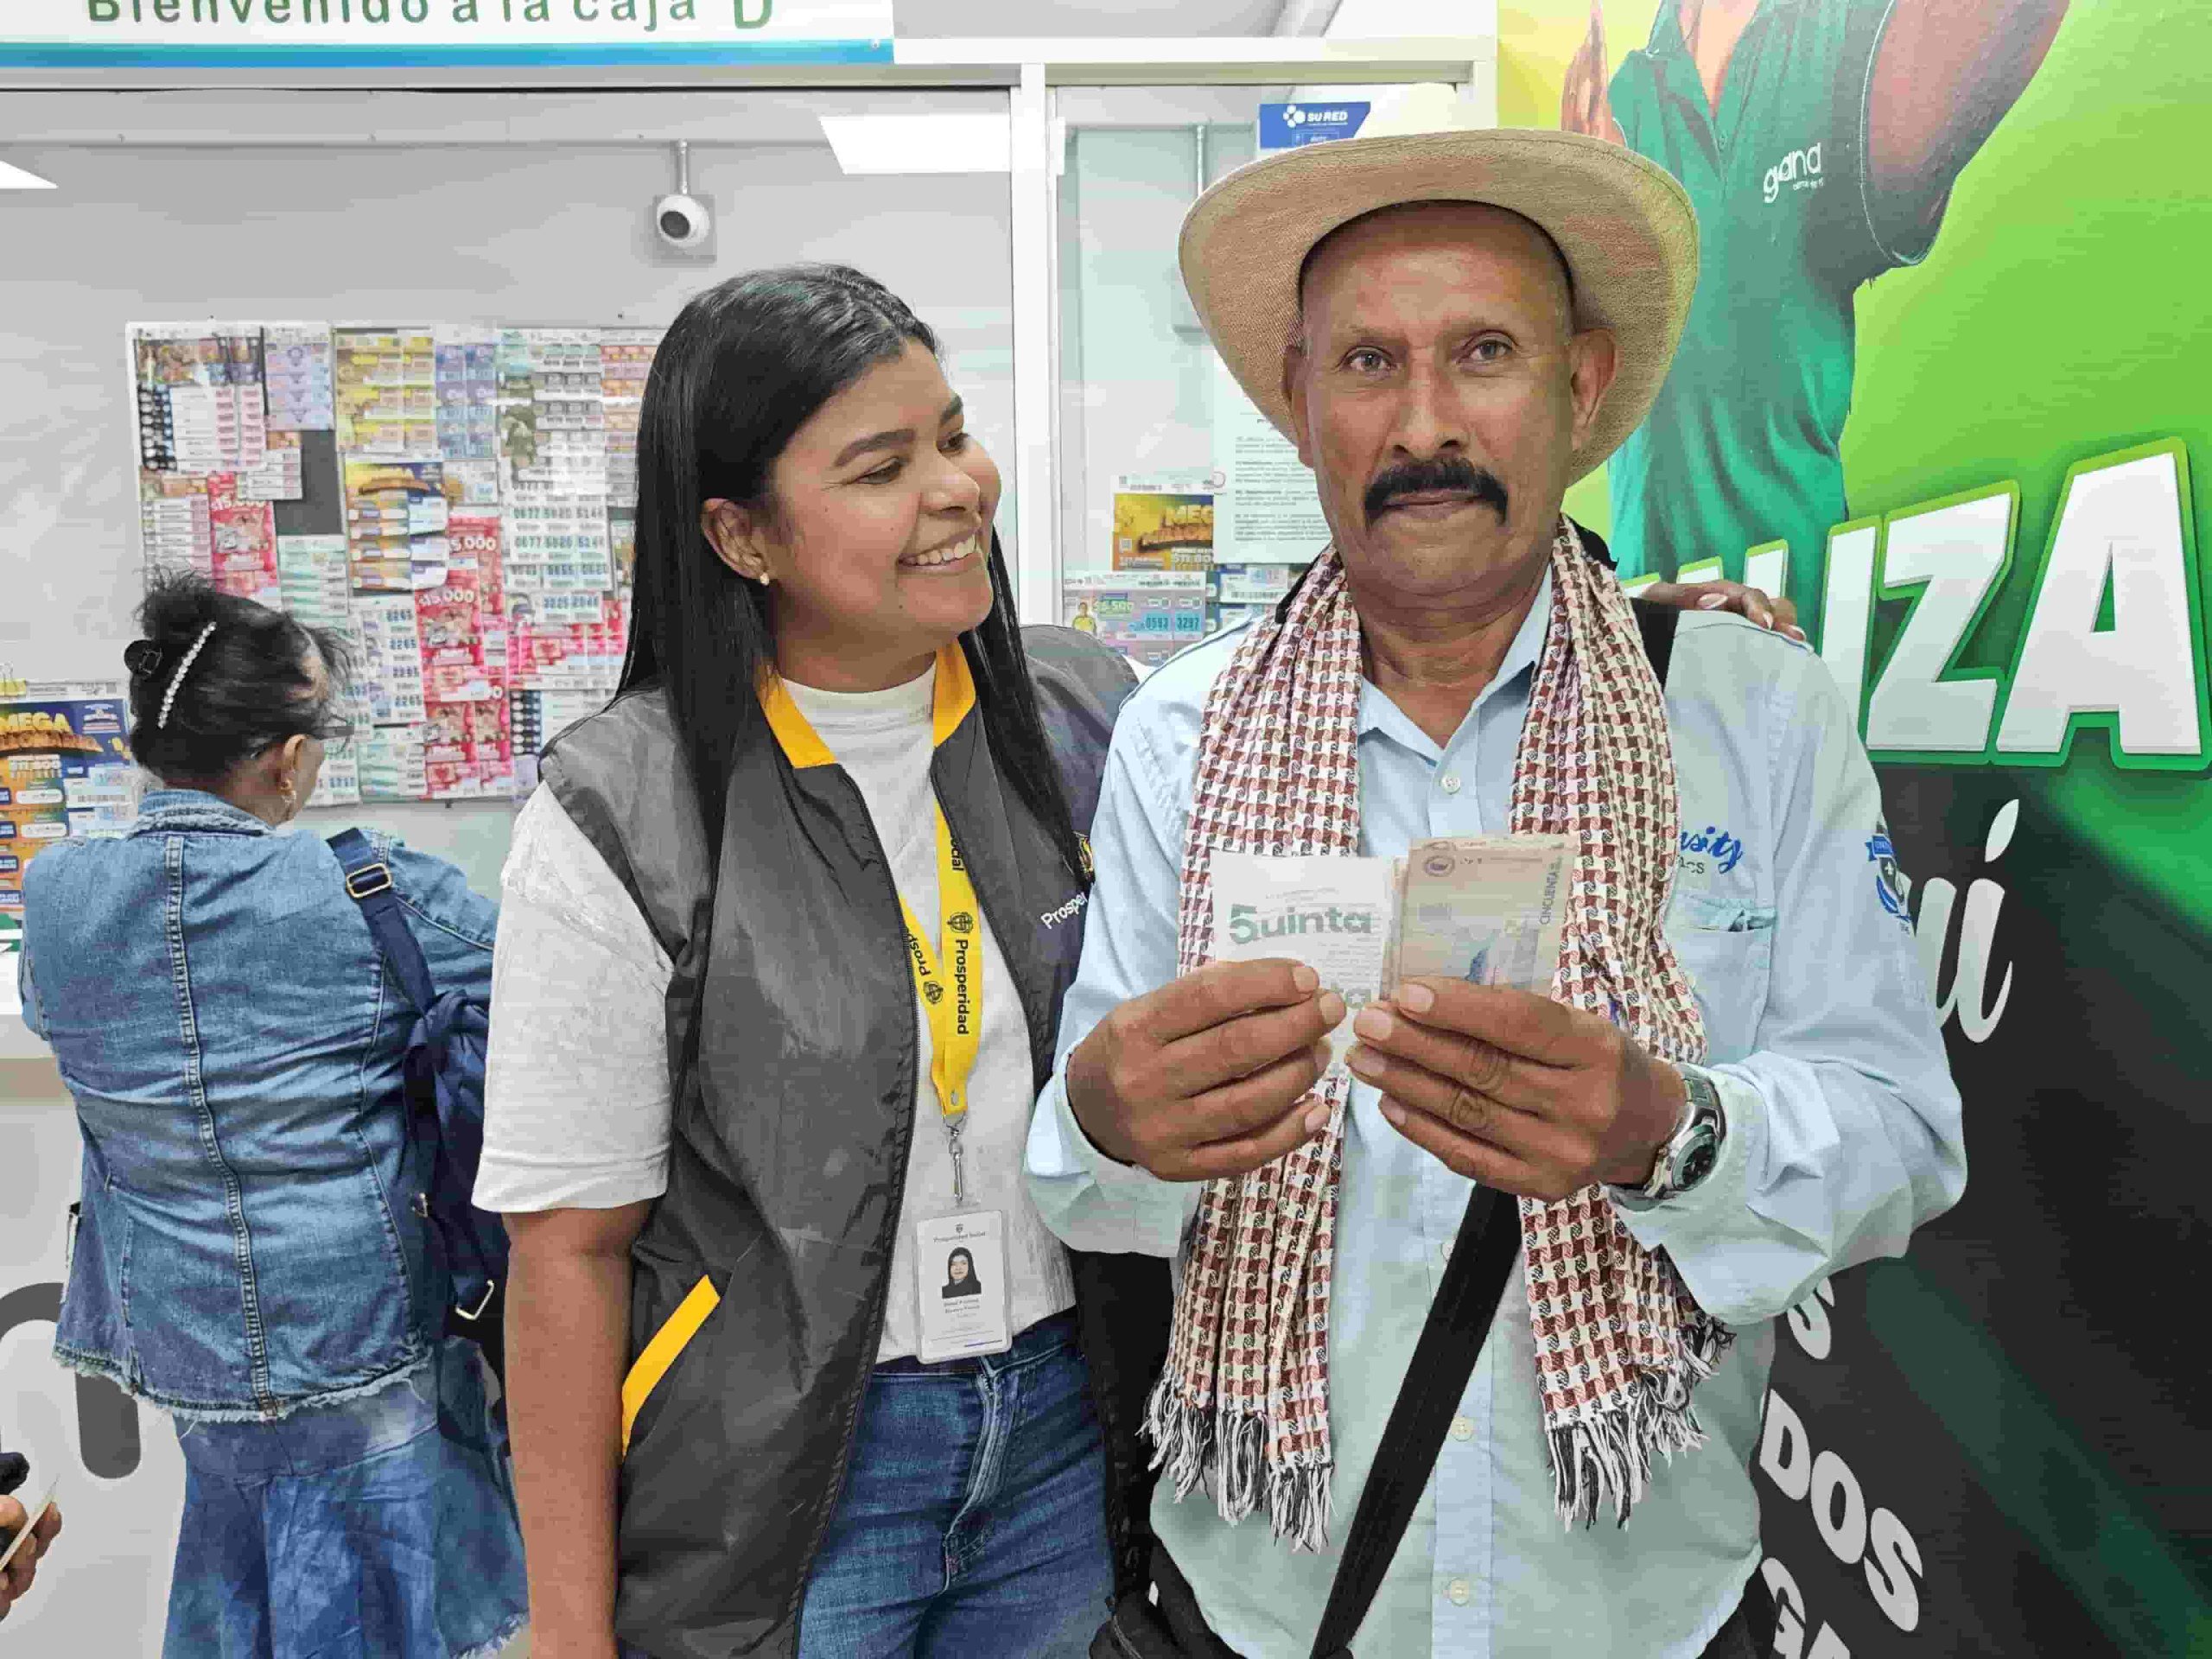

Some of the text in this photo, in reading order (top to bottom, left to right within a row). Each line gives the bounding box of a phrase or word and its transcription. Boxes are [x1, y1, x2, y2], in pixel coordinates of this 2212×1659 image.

[452, 0, 479, 22] a
[573, 0, 696, 32] caja
[955, 938, 969, 1035] Prosperidad
